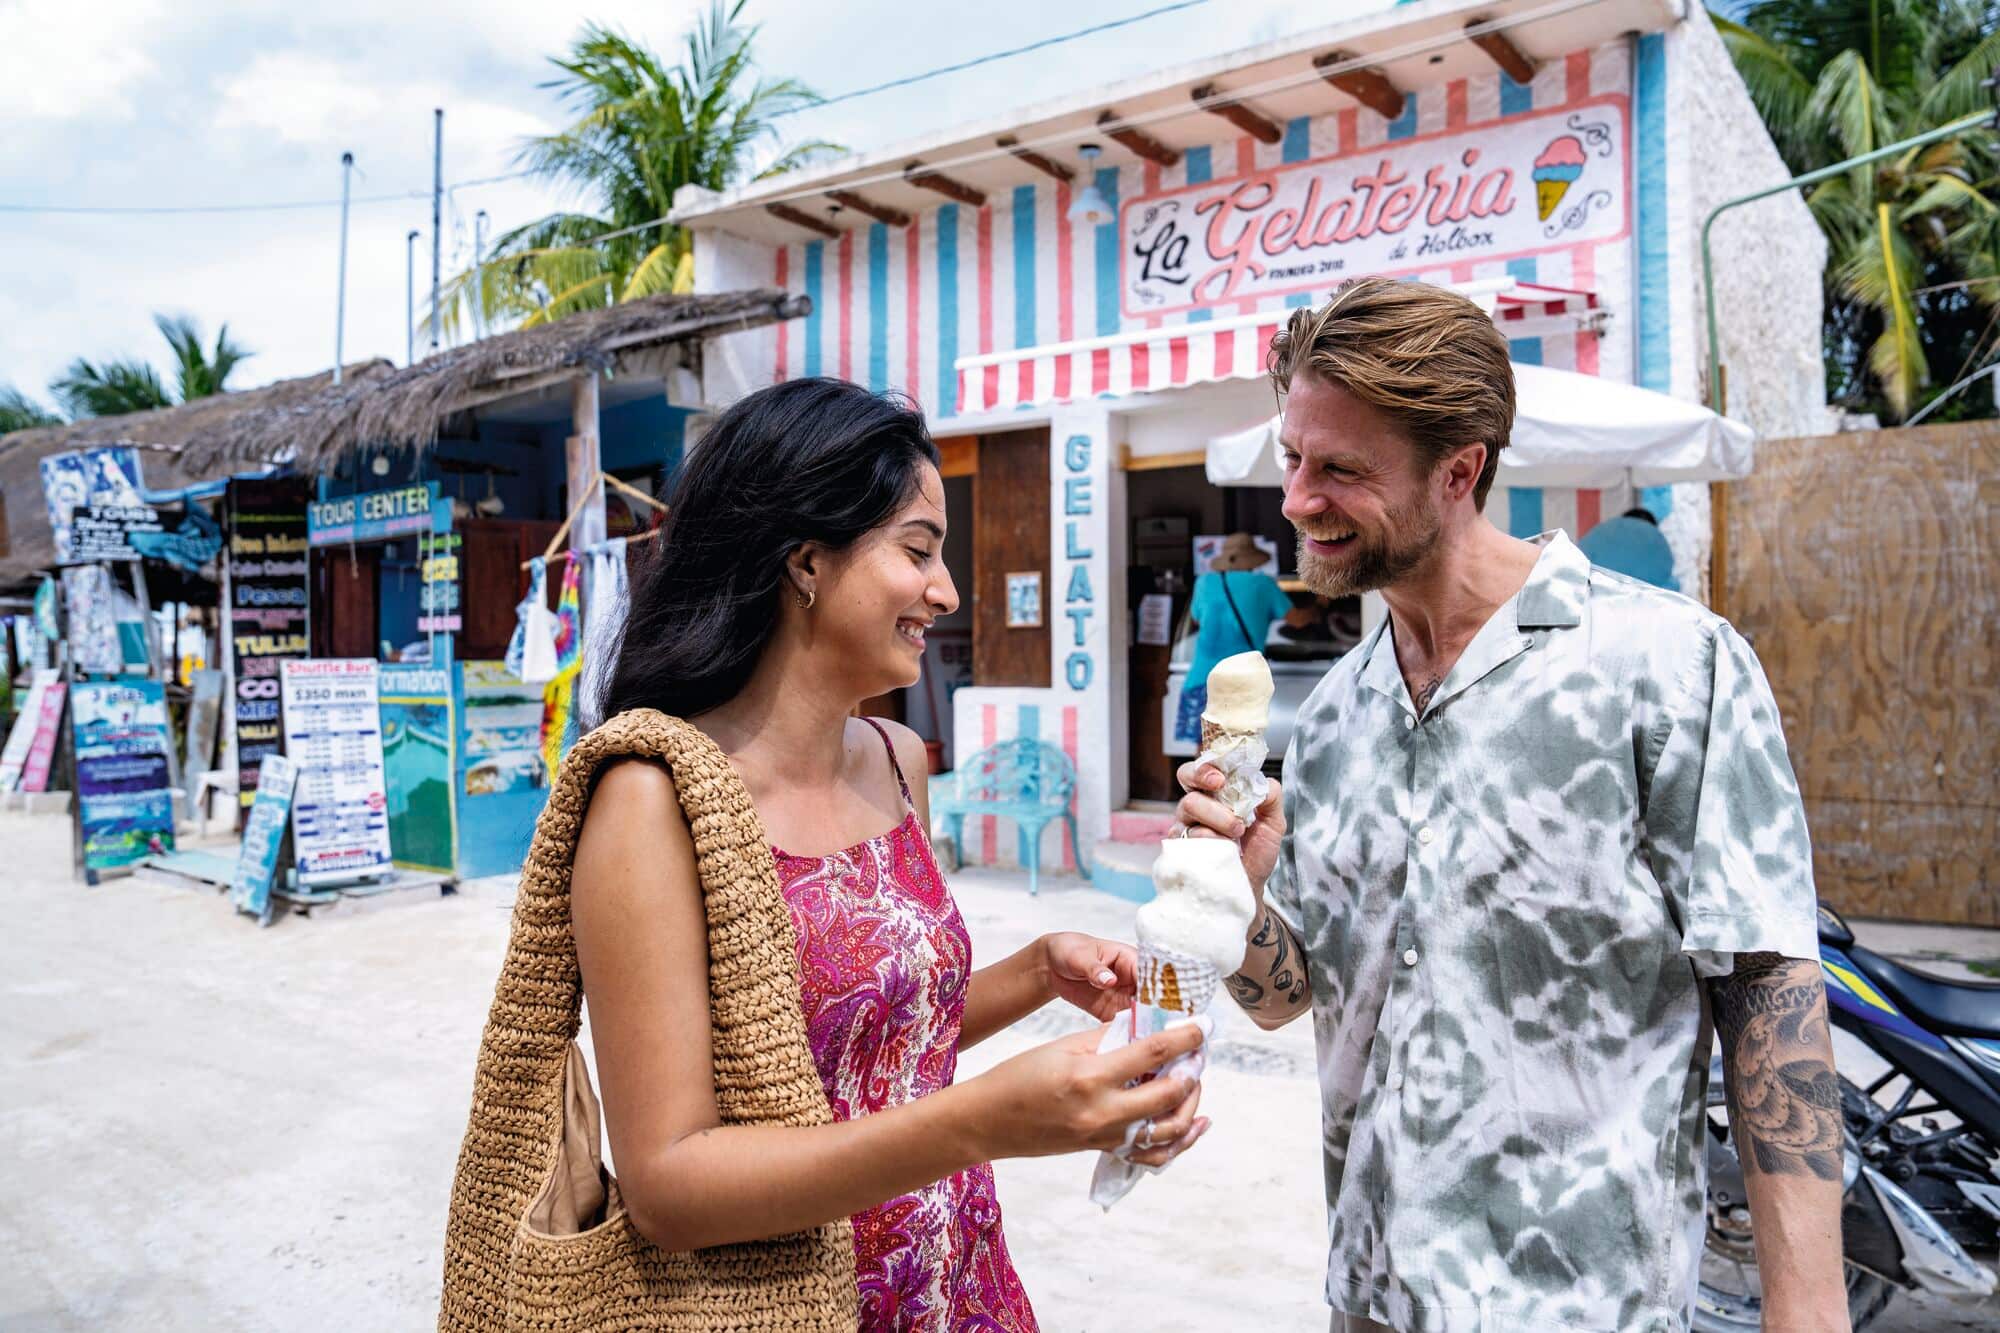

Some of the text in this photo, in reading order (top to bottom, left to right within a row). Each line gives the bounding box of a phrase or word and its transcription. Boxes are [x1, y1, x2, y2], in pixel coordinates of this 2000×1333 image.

[1134, 148, 1516, 304] La Gelateria
[1416, 227, 1494, 257] Holbox
[312, 486, 430, 528] TOUR CENTER
[1064, 434, 1094, 691] GELATO
[287, 661, 341, 675] Shuttle
[381, 670, 447, 694] ormation
